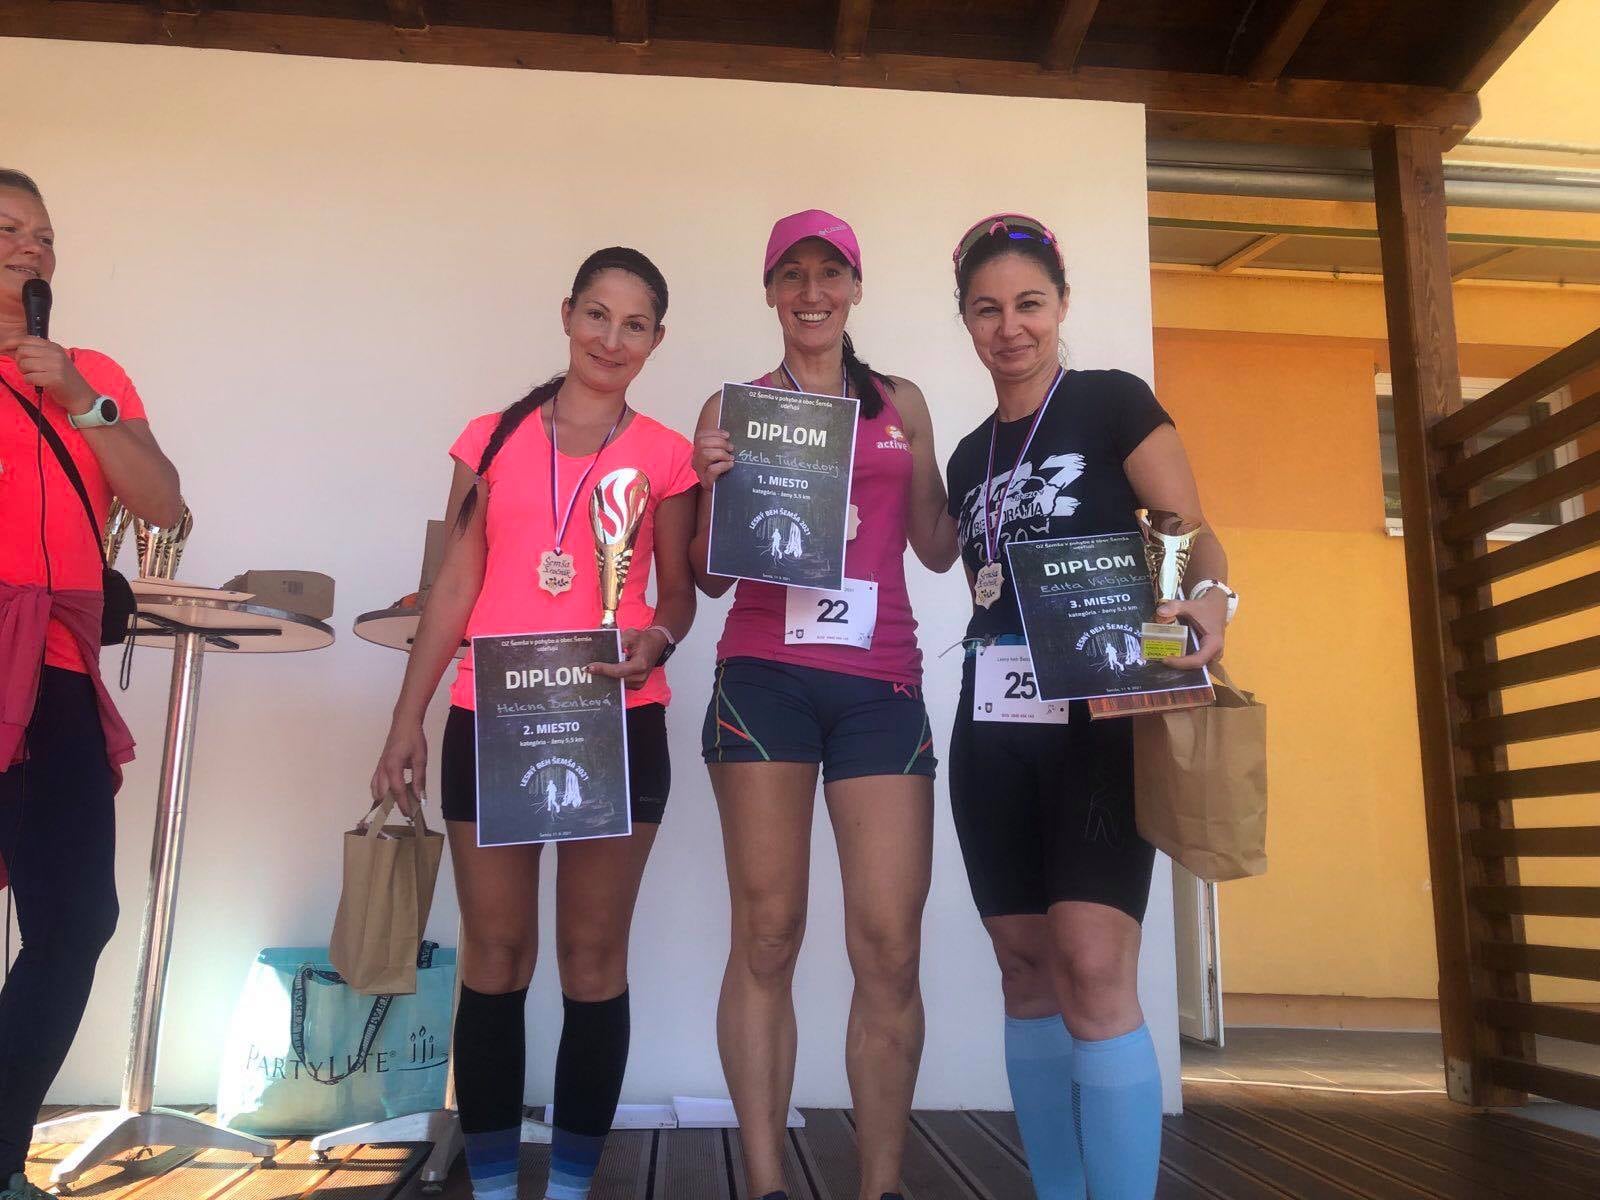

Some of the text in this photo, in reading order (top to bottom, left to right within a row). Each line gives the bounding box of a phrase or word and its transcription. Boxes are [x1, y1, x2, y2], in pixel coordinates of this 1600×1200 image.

[747, 420, 827, 448] DIPLOM
[758, 475, 809, 490] 1. MIESTO
[765, 509, 779, 517] BEH
[800, 520, 811, 535] 2021
[1043, 555, 1136, 577] DIPLOM
[1040, 581, 1084, 594] Edita
[817, 599, 849, 624] 22
[1069, 594, 1130, 609] 3. MIESTO
[1068, 610, 1097, 618] kategória
[1075, 632, 1091, 651] LESNÝ
[1090, 625, 1105, 635] BEH
[1106, 622, 1134, 632] ŠEMŠA
[506, 666, 593, 690] DIPLOM
[1004, 672, 1037, 699] 25
[497, 702, 546, 713] Helena
[523, 721, 580, 735] 2. MIESTO
[520, 756, 589, 787] LESNÝ BEH ŠEMŠA 2021
